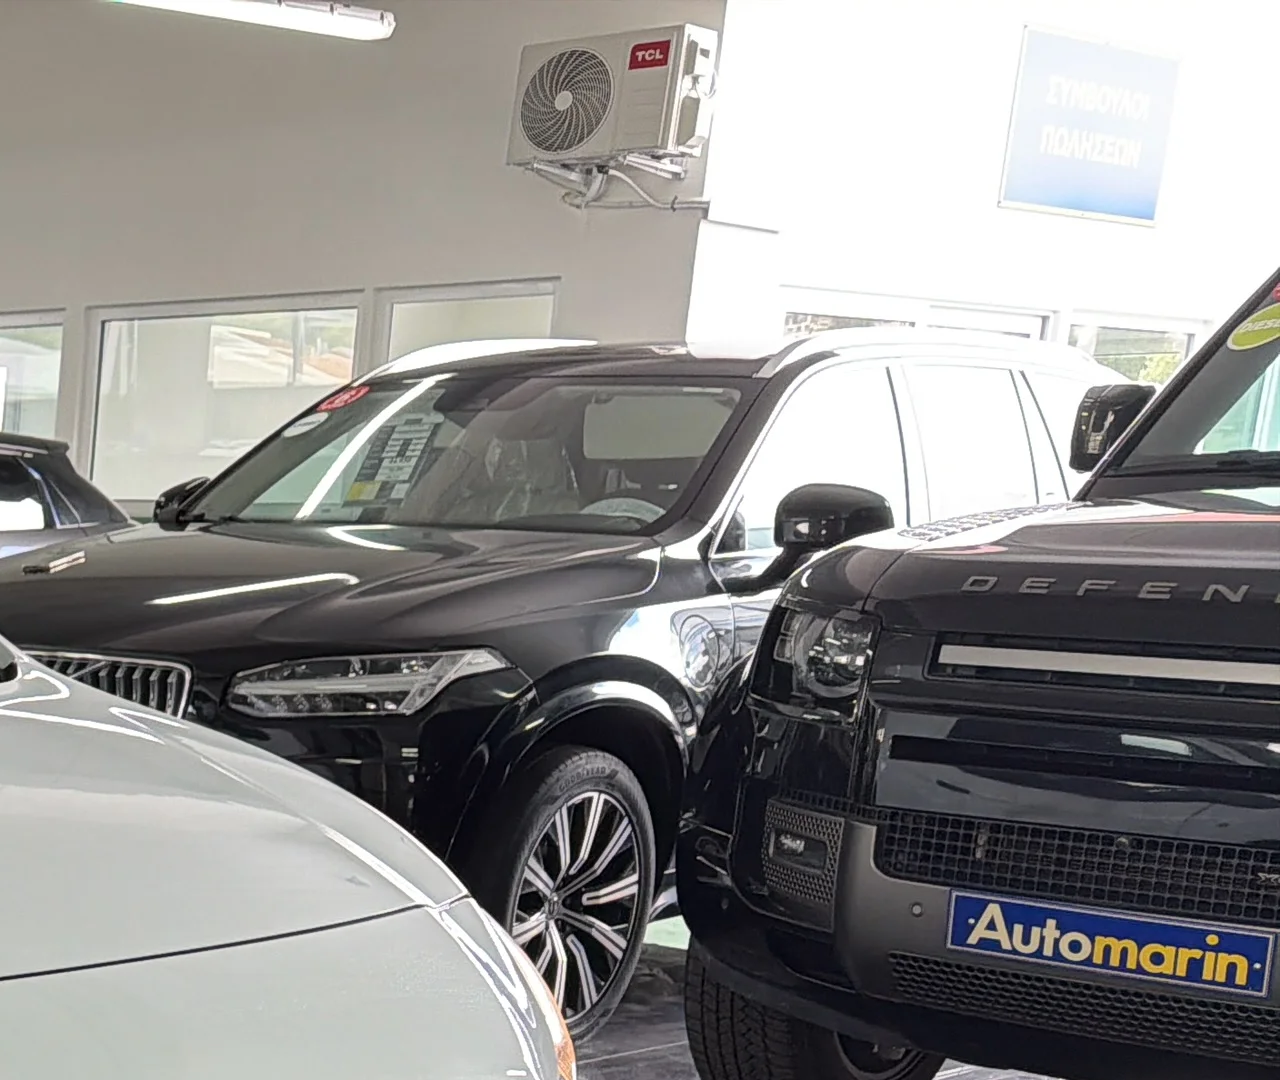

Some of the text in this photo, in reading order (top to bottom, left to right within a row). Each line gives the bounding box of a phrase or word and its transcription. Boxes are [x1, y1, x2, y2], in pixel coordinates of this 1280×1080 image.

[635, 48, 664, 62] TCL
[1045, 74, 1151, 122] ΣΥΜΒΟΥΛΟΙ
[1040, 124, 1142, 169] ΠΩΛΗΣΕΩΝ
[960, 575, 1280, 604] DEFEN
[966, 902, 1249, 986] Automarin
